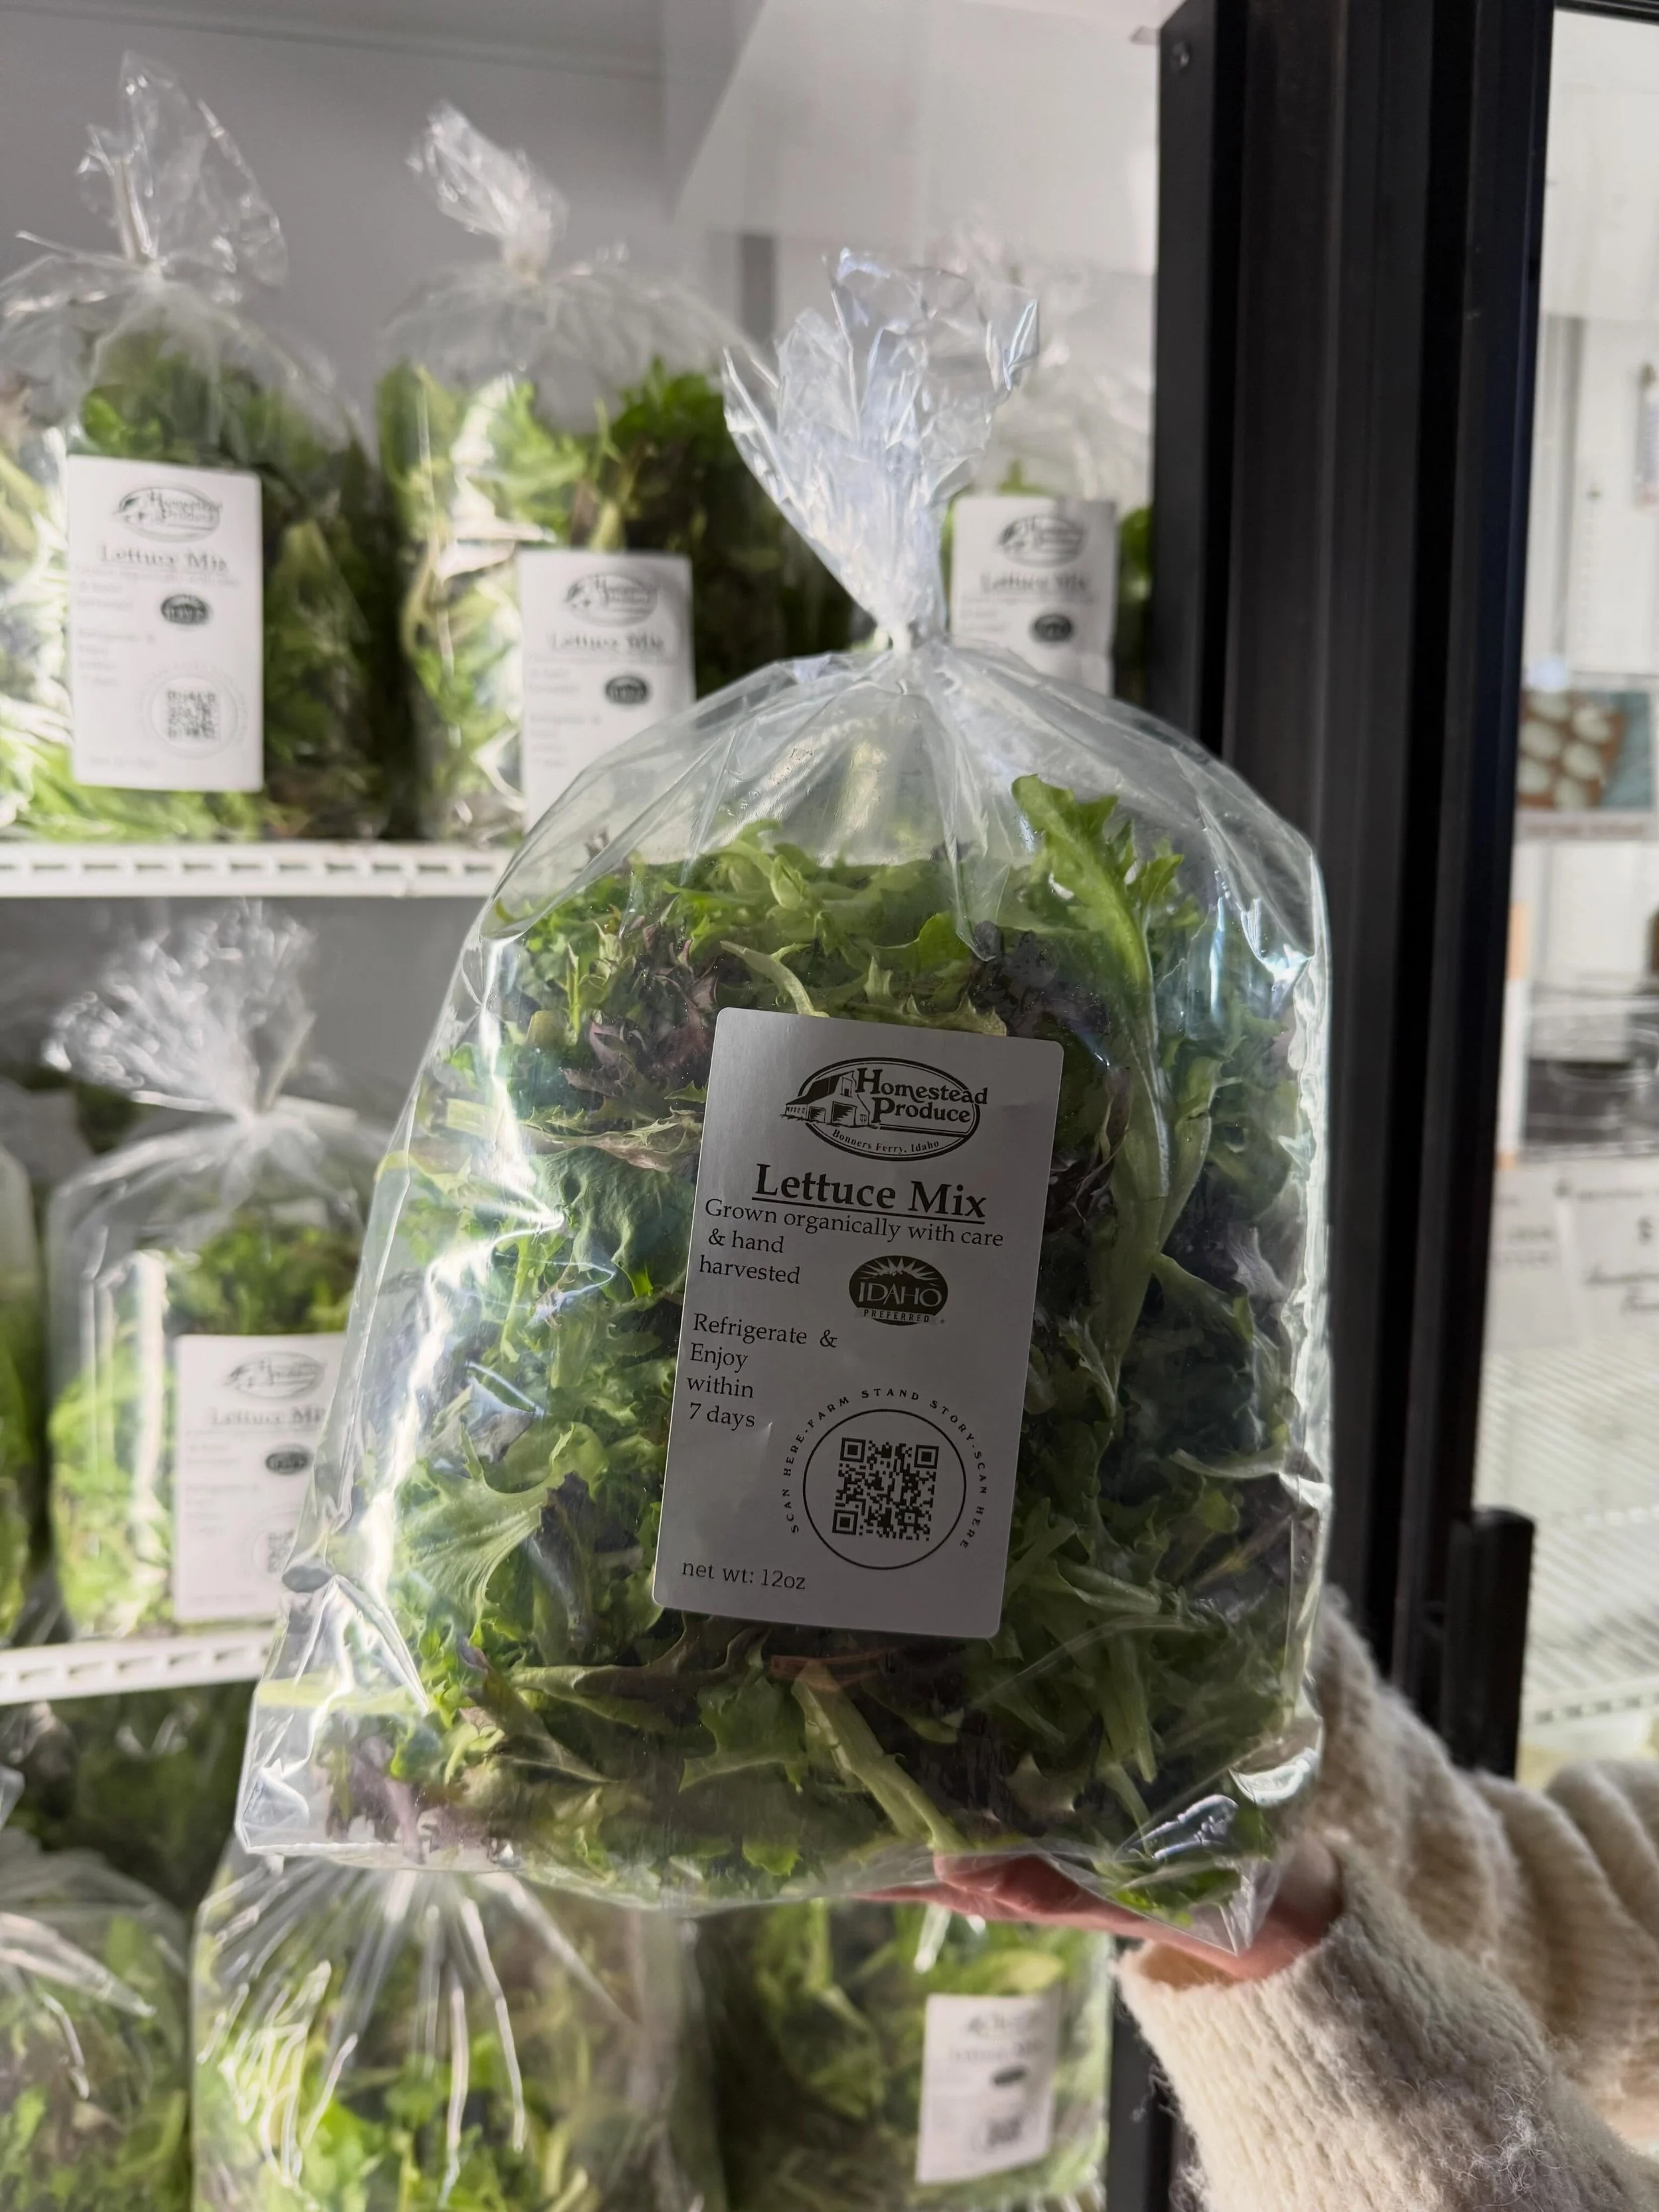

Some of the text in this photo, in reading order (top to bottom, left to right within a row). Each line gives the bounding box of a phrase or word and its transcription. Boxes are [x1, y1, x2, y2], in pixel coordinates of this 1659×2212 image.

[855, 1067, 987, 1104] Homestead
[871, 1097, 971, 1123] Produce
[832, 1129, 872, 1149] Bonners
[911, 1140, 939, 1153] Idaho
[756, 1163, 987, 1218] Lettuce Mix
[705, 1198, 1003, 1247] Grown organically with care
[708, 1228, 784, 1254] & hand
[699, 1255, 800, 1284] harvested
[859, 1282, 942, 1307] IDAHO
[693, 1313, 838, 1348] Refrigerate &
[864, 1309, 929, 1323] PREFERRED
[689, 1342, 749, 1374] Enjoy
[687, 1374, 755, 1398] within
[689, 1402, 755, 1431] 7 days
[782, 1489, 799, 1534] SCAN
[861, 1388, 919, 1401] STAND
[960, 1506, 985, 1548] HERE
[682, 1560, 806, 1591] net wt: 12oz
